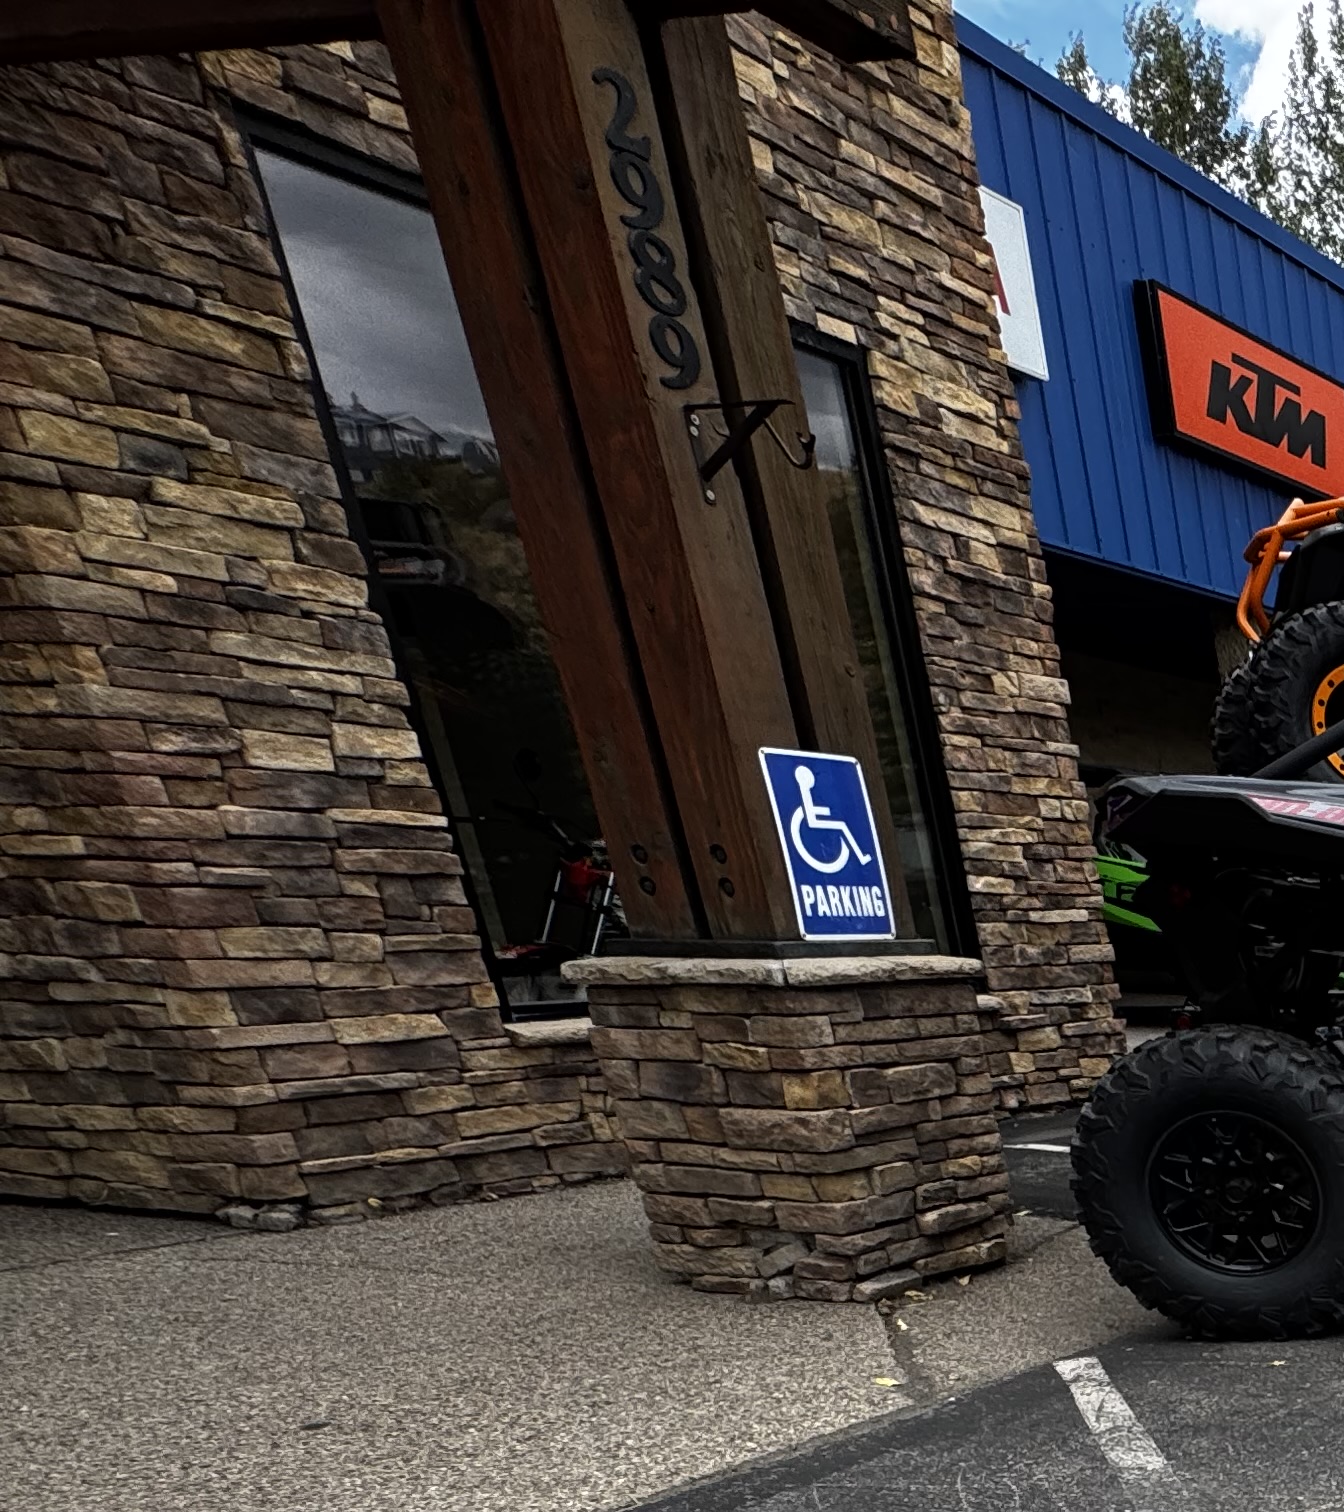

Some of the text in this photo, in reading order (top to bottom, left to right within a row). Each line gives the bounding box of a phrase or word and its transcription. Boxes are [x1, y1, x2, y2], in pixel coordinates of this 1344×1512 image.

[592, 67, 699, 390] 2989
[1206, 352, 1326, 470] KTM
[800, 884, 886, 918] PARKING
